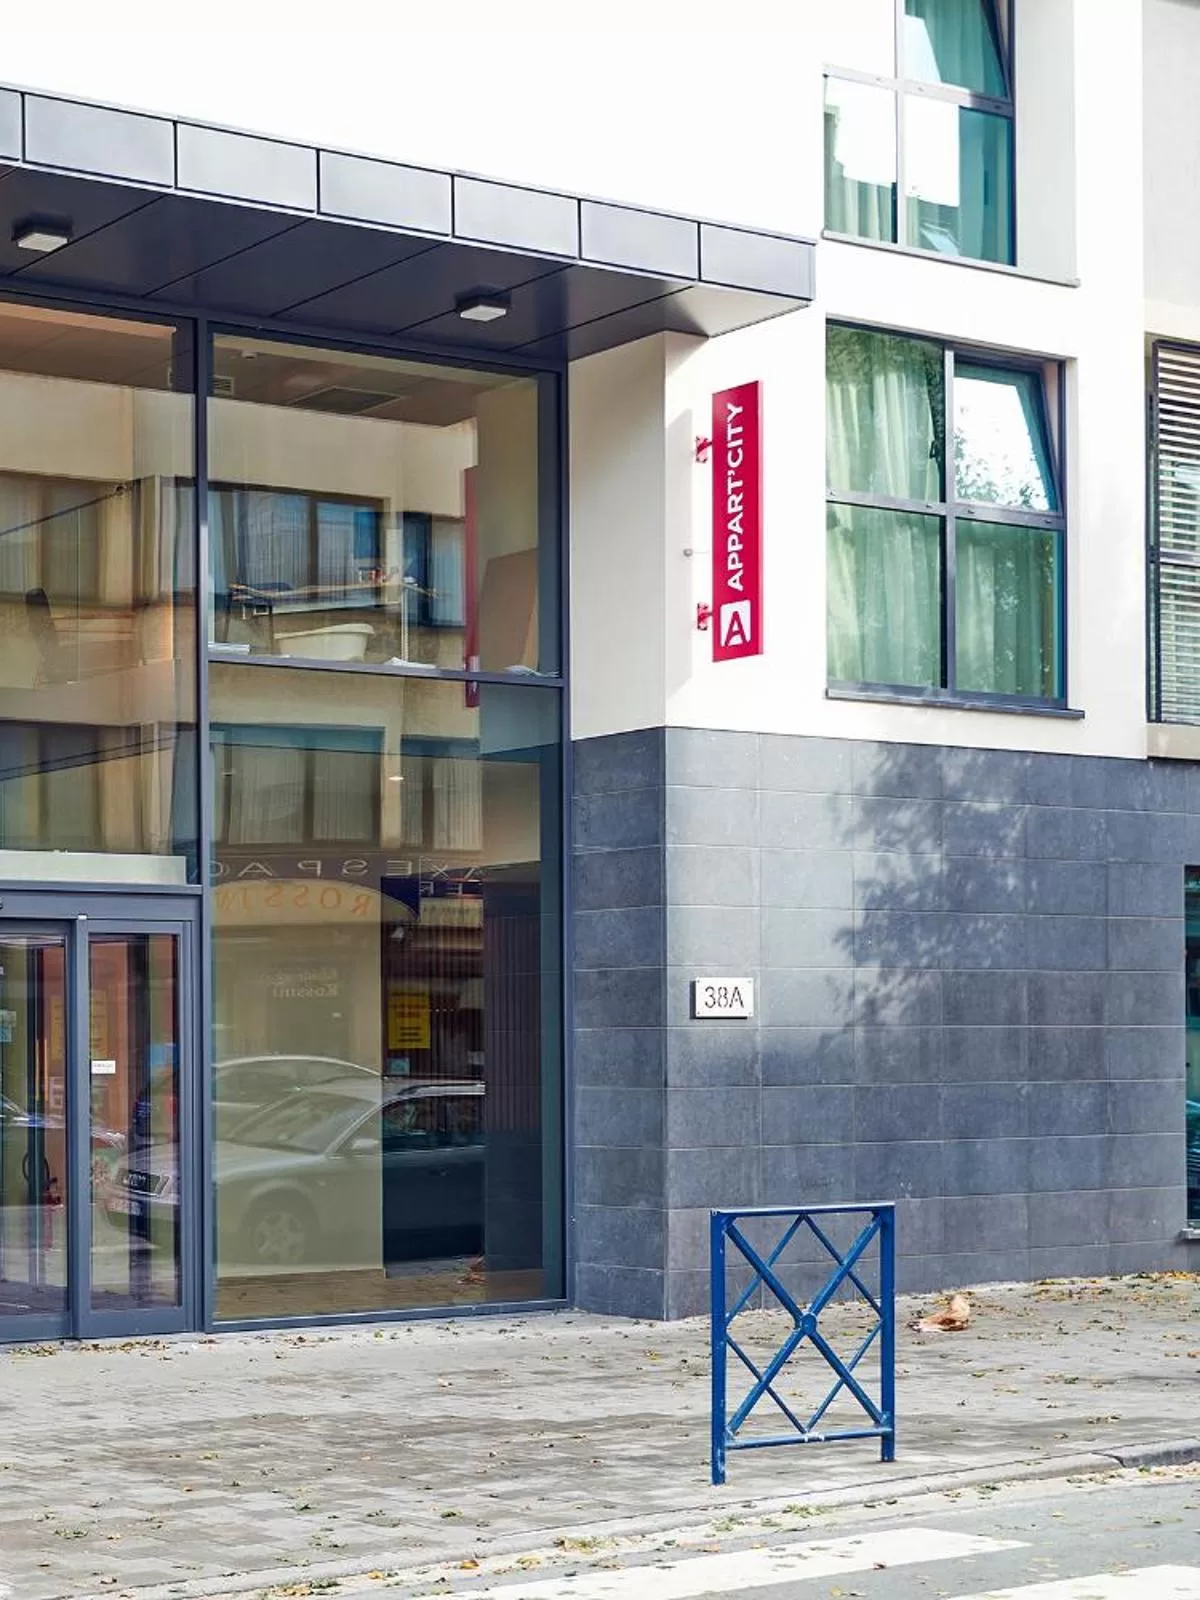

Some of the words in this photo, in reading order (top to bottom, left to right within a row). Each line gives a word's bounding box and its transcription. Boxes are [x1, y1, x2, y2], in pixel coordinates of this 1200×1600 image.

[726, 402, 744, 592] APPART'CITY
[723, 606, 749, 647] A
[704, 985, 744, 1009] 38A
